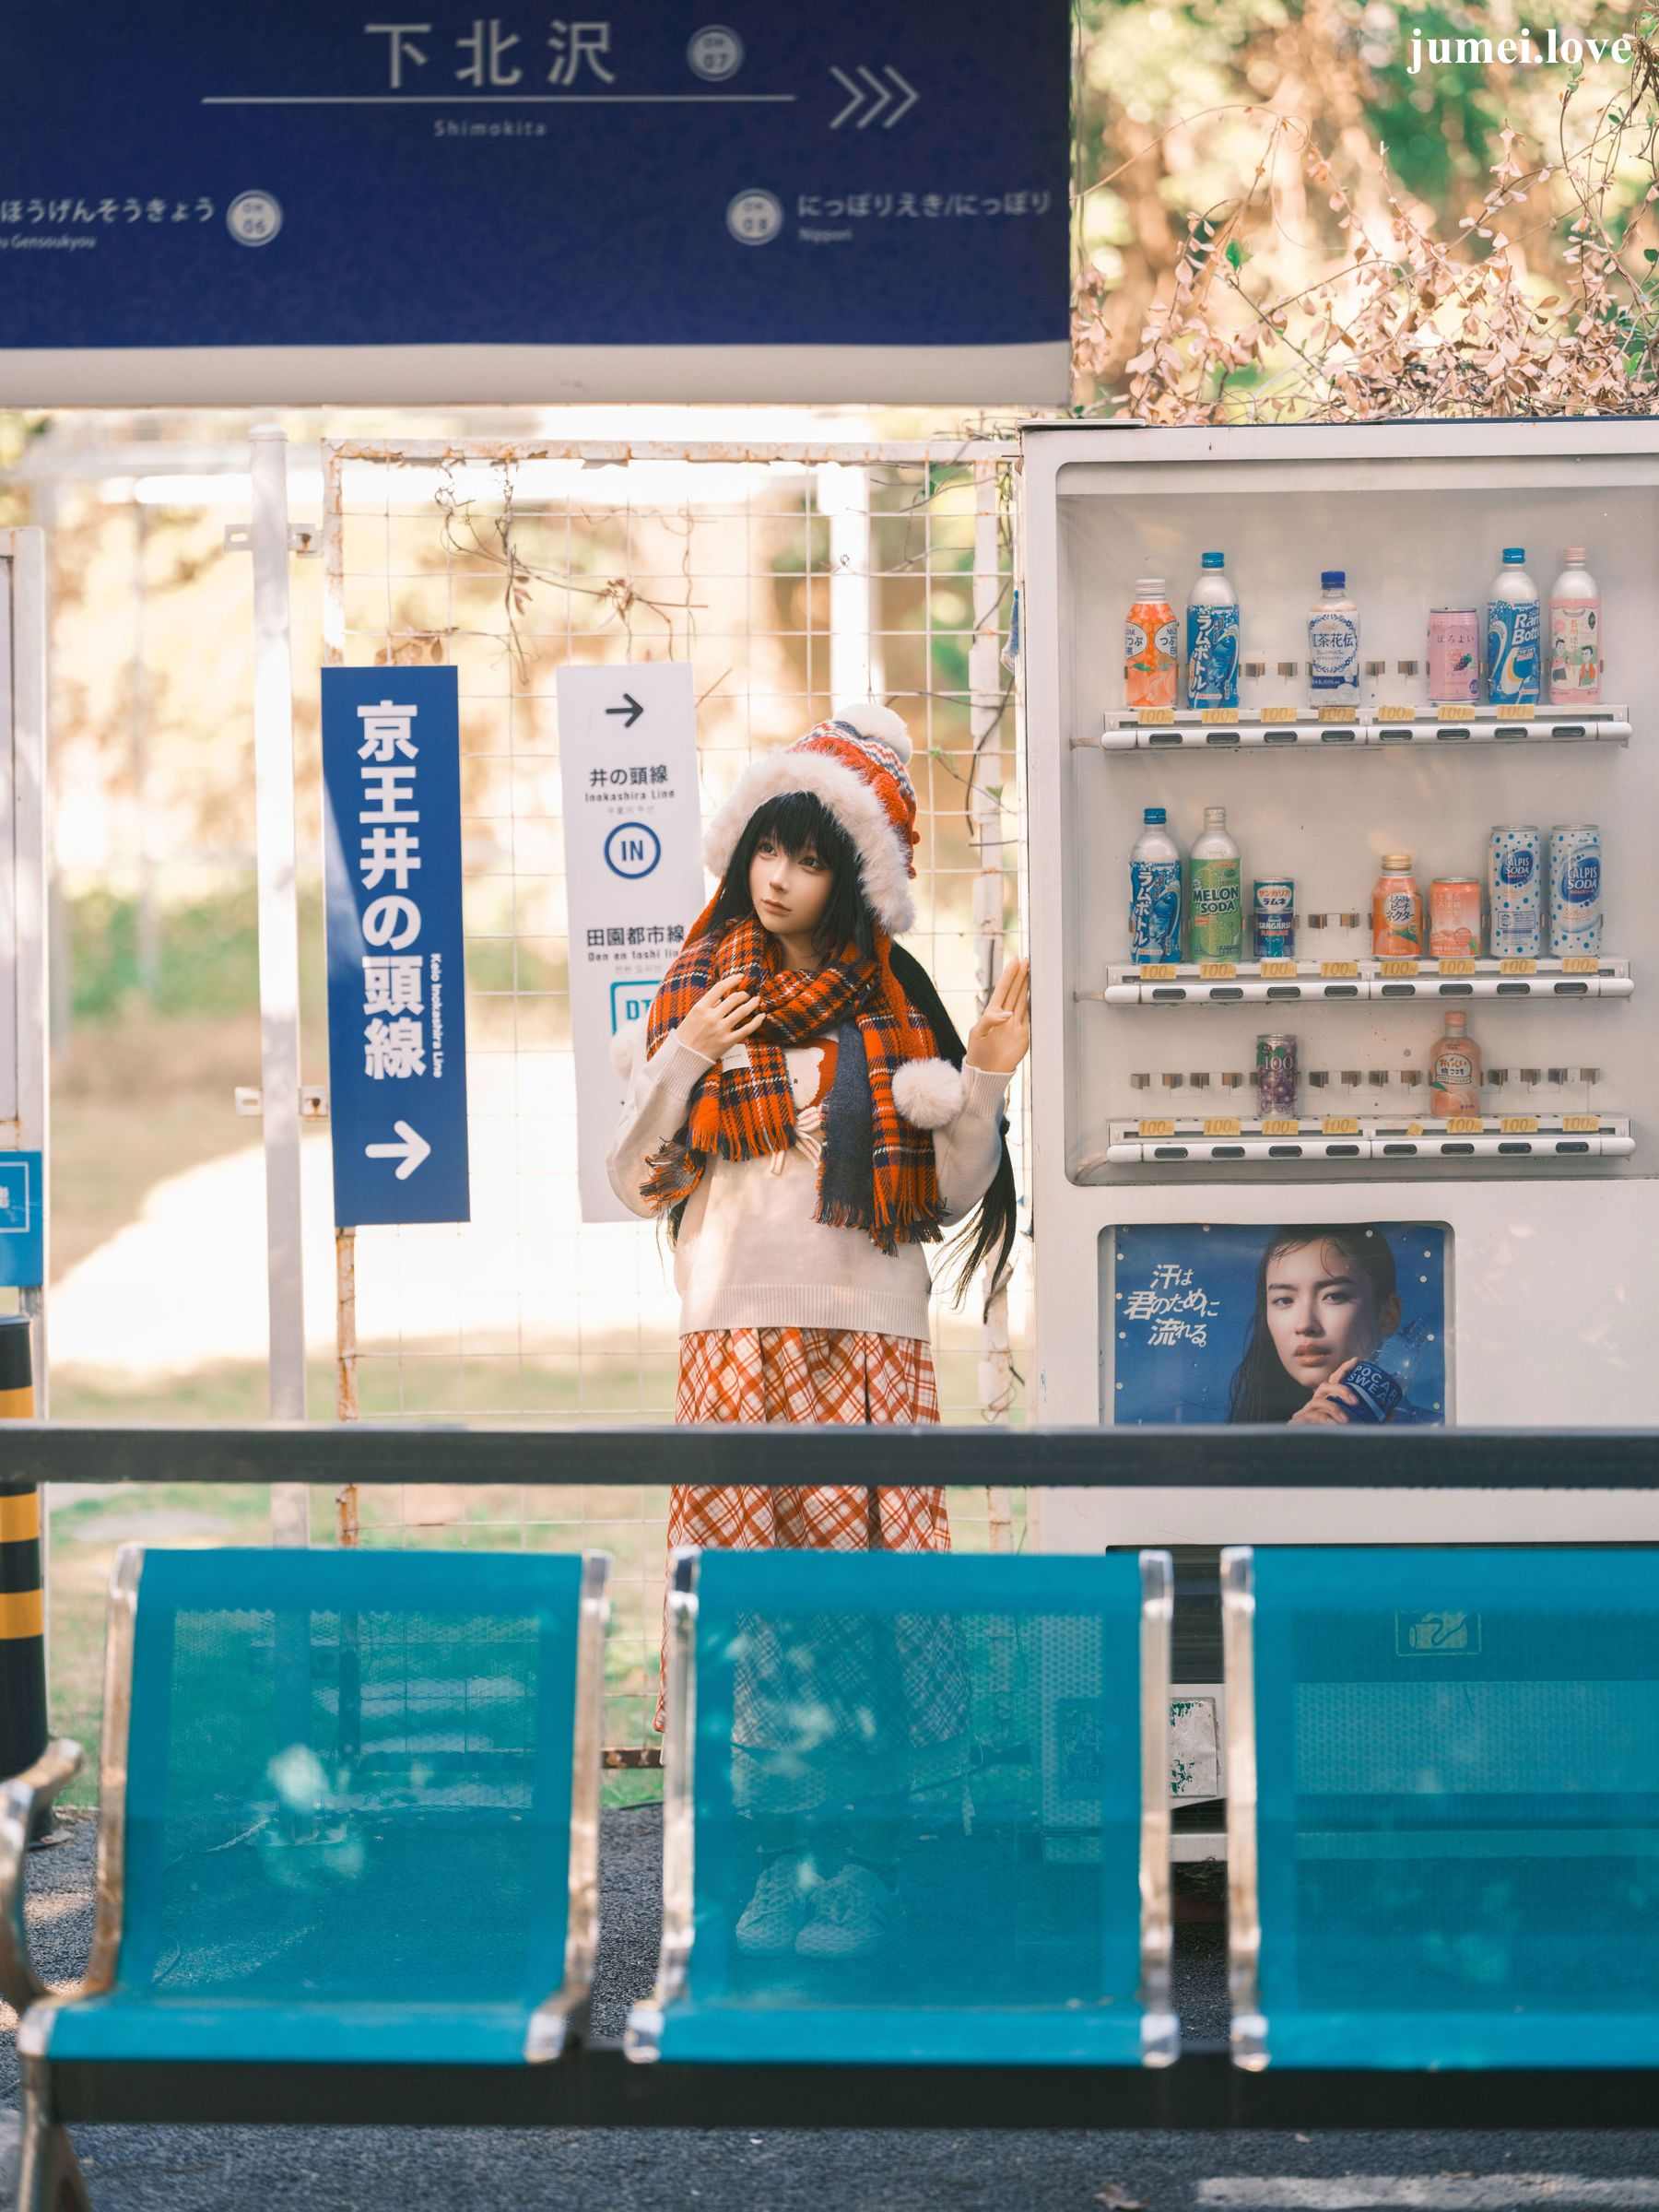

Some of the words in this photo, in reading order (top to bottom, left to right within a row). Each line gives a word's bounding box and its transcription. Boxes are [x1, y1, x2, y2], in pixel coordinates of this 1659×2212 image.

[363, 18, 616, 89] 下北沢
[433, 119, 547, 137] Shimokita
[589, 763, 669, 787] 井の頭線
[584, 793, 646, 802] Inokashira
[651, 790, 676, 800] Line
[620, 840, 644, 862] IN
[357, 700, 427, 1079] 京王井の頭線
[1193, 885, 1239, 902] MELON
[1568, 878, 1597, 890] SODA
[1200, 901, 1235, 914] SODA
[587, 924, 685, 947] 田園都市線
[429, 953, 441, 982] Keio
[587, 951, 609, 961] Den
[614, 951, 628, 960] en
[430, 983, 443, 1050] Inokashira
[432, 1051, 444, 1078] Line
[1149, 1264, 1195, 1289] 汗は
[1123, 1288, 1220, 1321] 君のために
[1147, 1317, 1208, 1348] 流れる。
